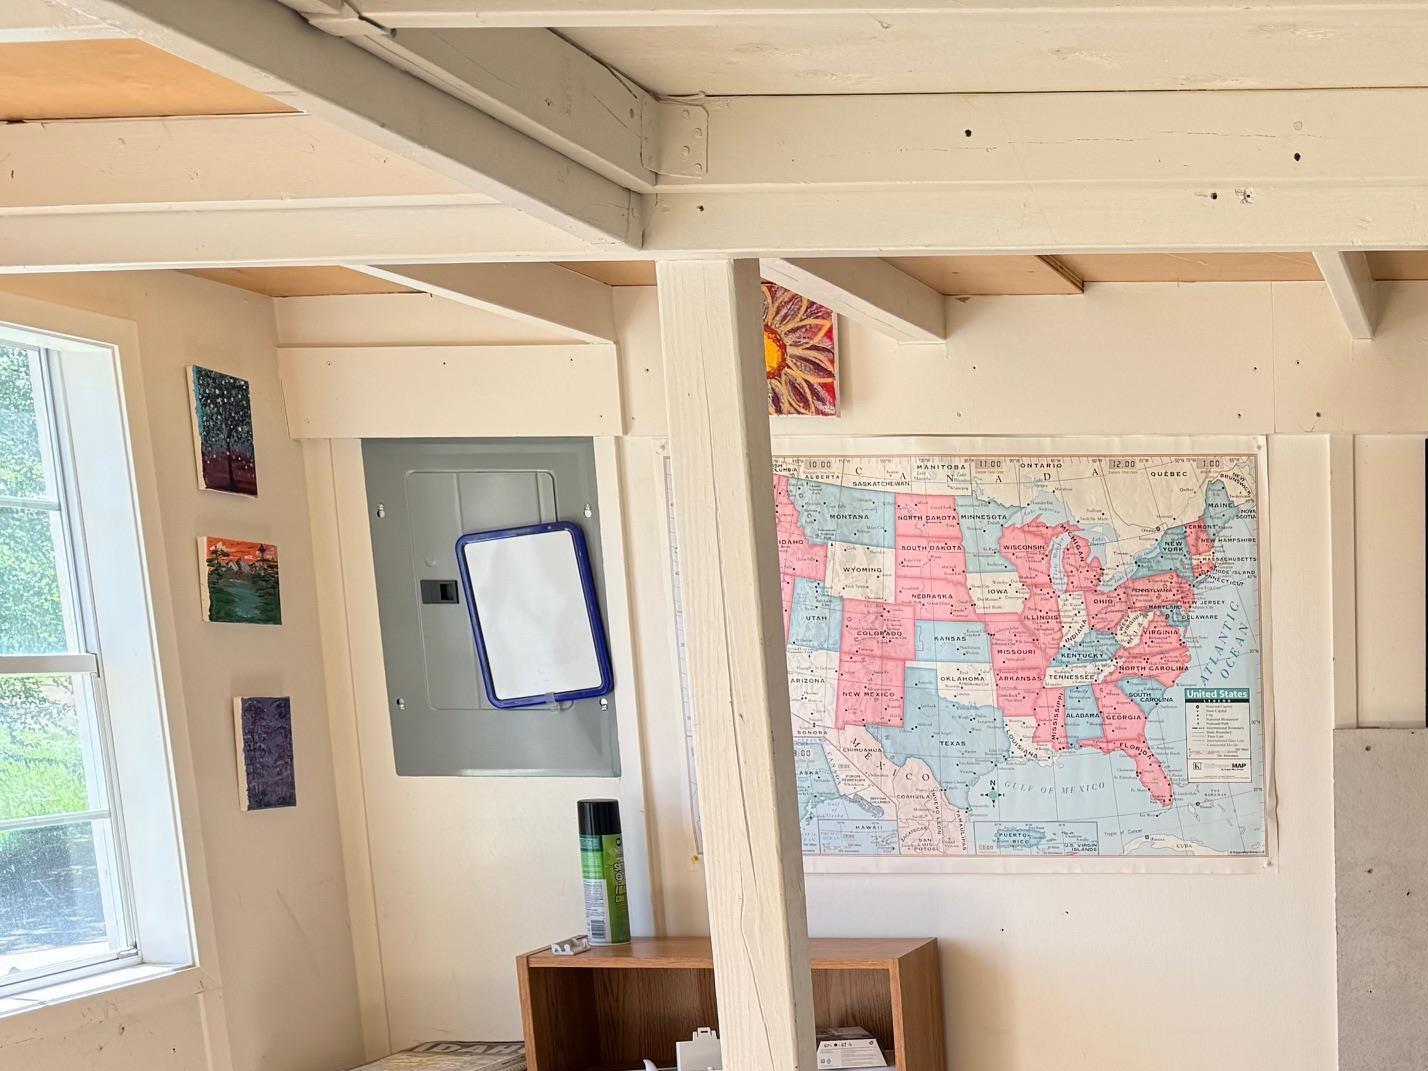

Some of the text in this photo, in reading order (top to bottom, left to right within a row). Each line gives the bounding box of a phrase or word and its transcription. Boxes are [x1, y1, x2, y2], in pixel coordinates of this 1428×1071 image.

[1113, 460, 1136, 468] 12:00
[1232, 472, 1246, 482] NEW
[1059, 524, 1085, 563] MICHIGAN
[1064, 619, 1088, 644] INDIANA
[1119, 615, 1132, 632] WEST
[1122, 612, 1145, 635] VIRGINIA
[1200, 600, 1240, 687] ATLANTIC
[1220, 622, 1249, 680] OCEAN
[1187, 689, 1247, 698] United States
[1052, 692, 1064, 740] MISSISSIPPI
[1005, 728, 1039, 759] LOUISIANA
[1119, 742, 1153, 760] FLORIDA
[1003, 781, 1106, 795] GULF OF MEXICO
[421, 1042, 526, 1054] IDAH
